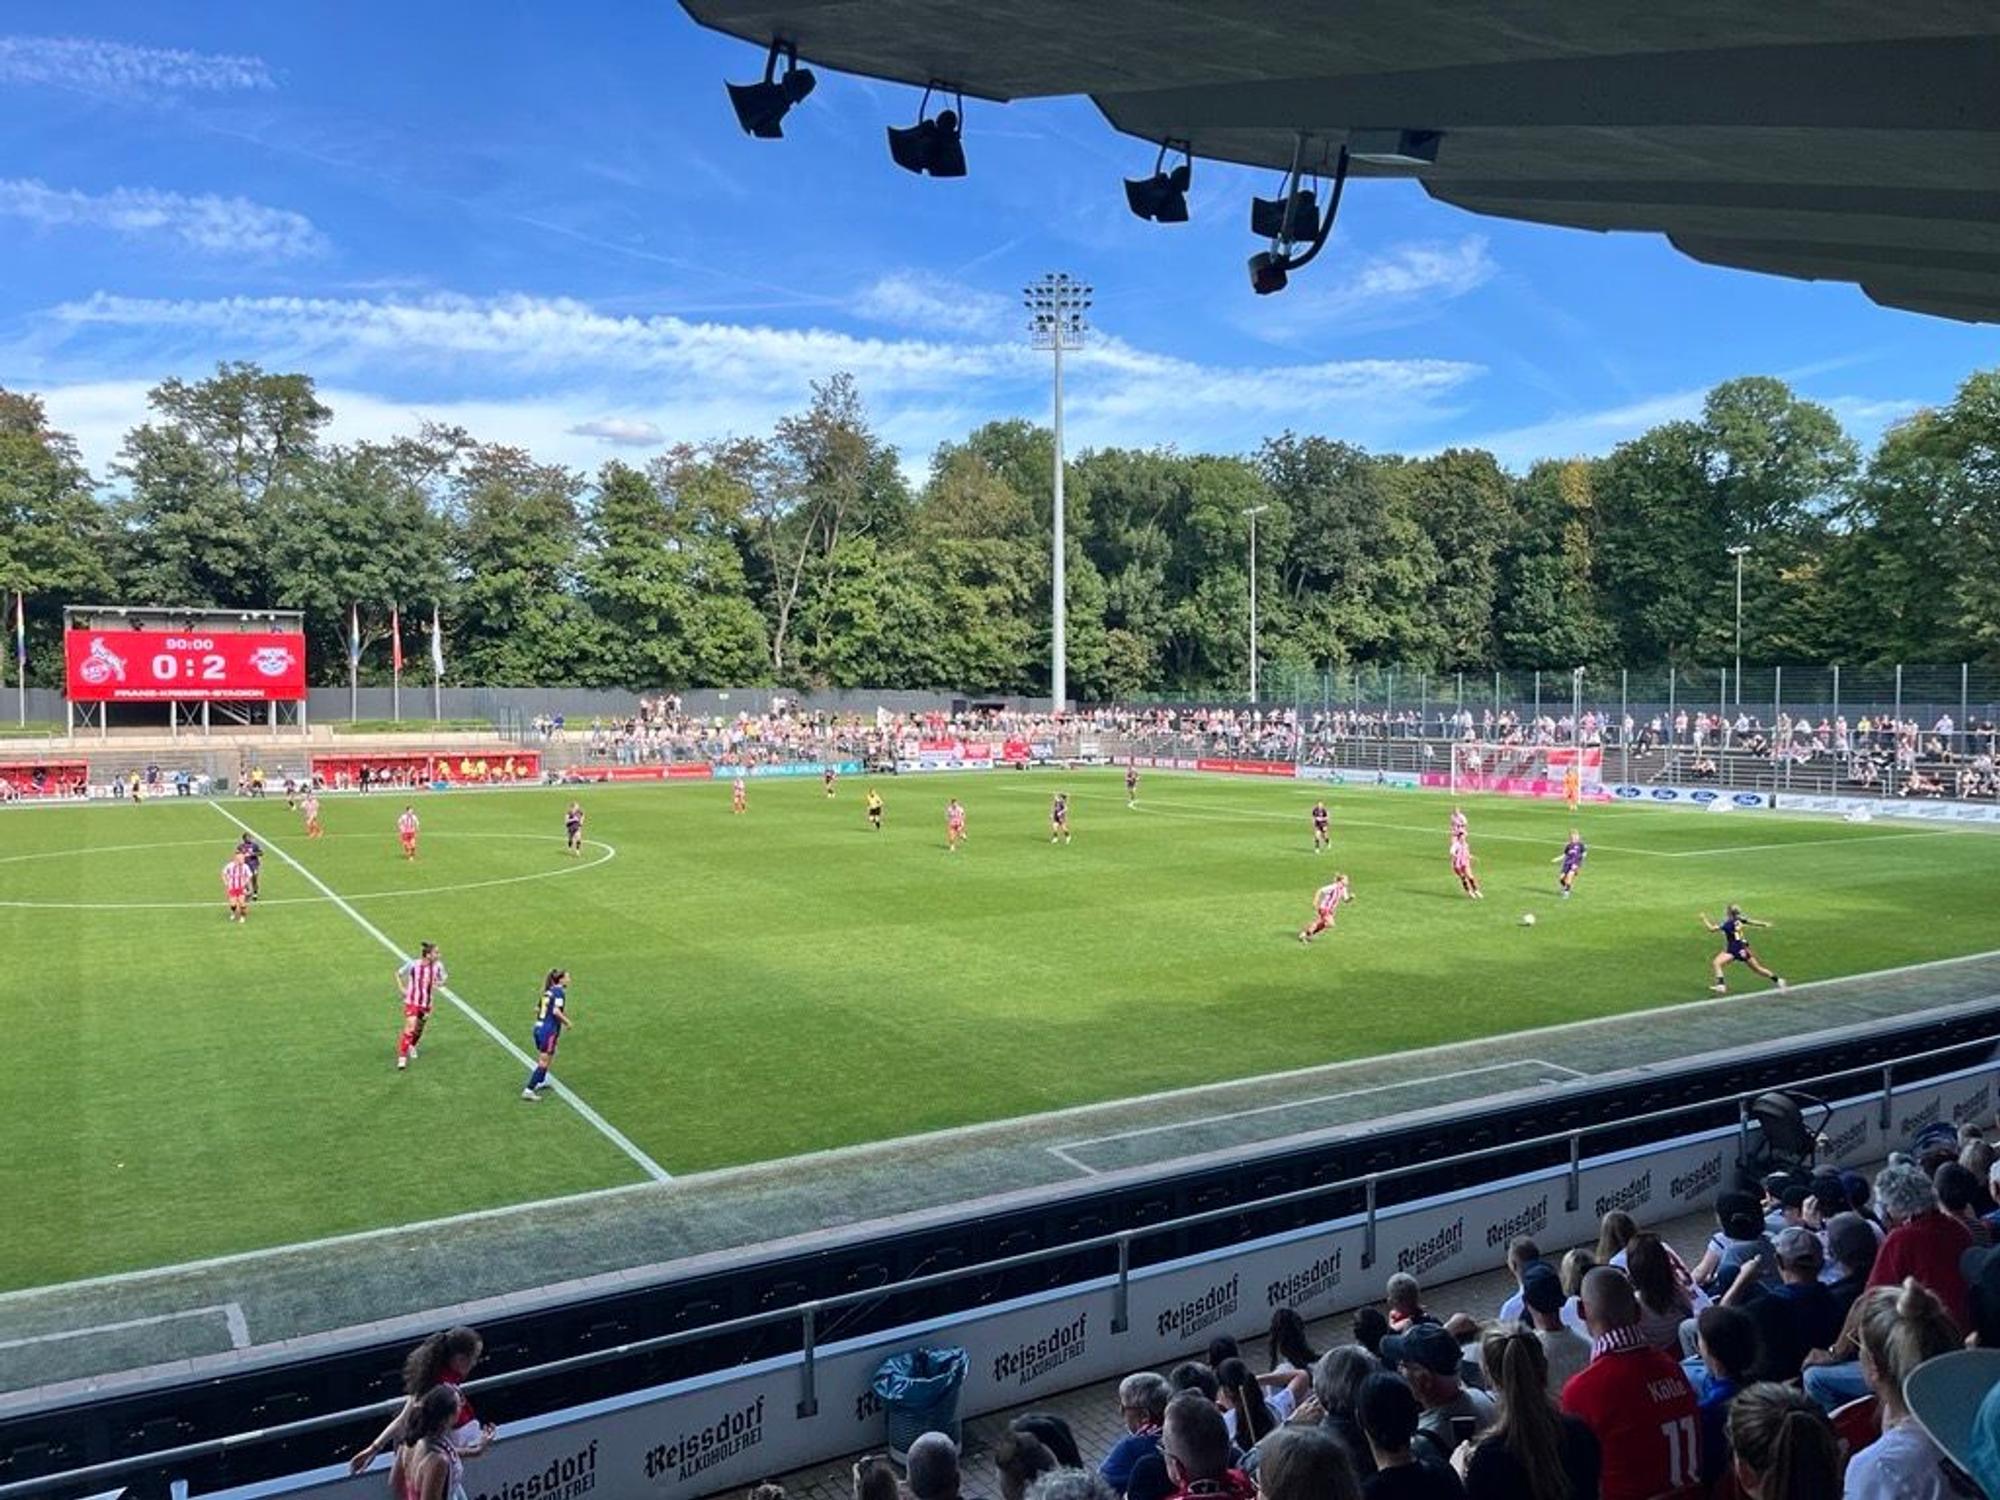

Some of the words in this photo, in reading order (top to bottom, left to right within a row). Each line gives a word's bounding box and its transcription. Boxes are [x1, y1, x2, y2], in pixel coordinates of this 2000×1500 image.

[166, 638, 214, 650] 90:00
[1397, 1216, 1464, 1272] Reissdorf
[1487, 1194, 1548, 1248] Reissdorf
[1156, 1273, 1240, 1336] Reissdorf
[1267, 1248, 1342, 1306] Reissdorf
[993, 1312, 1088, 1382] Reissdorf
[645, 1395, 765, 1478] Reissdorf
[678, 1427, 763, 1481] ALKOHOLFREI
[1660, 1415, 1700, 1488] 11
